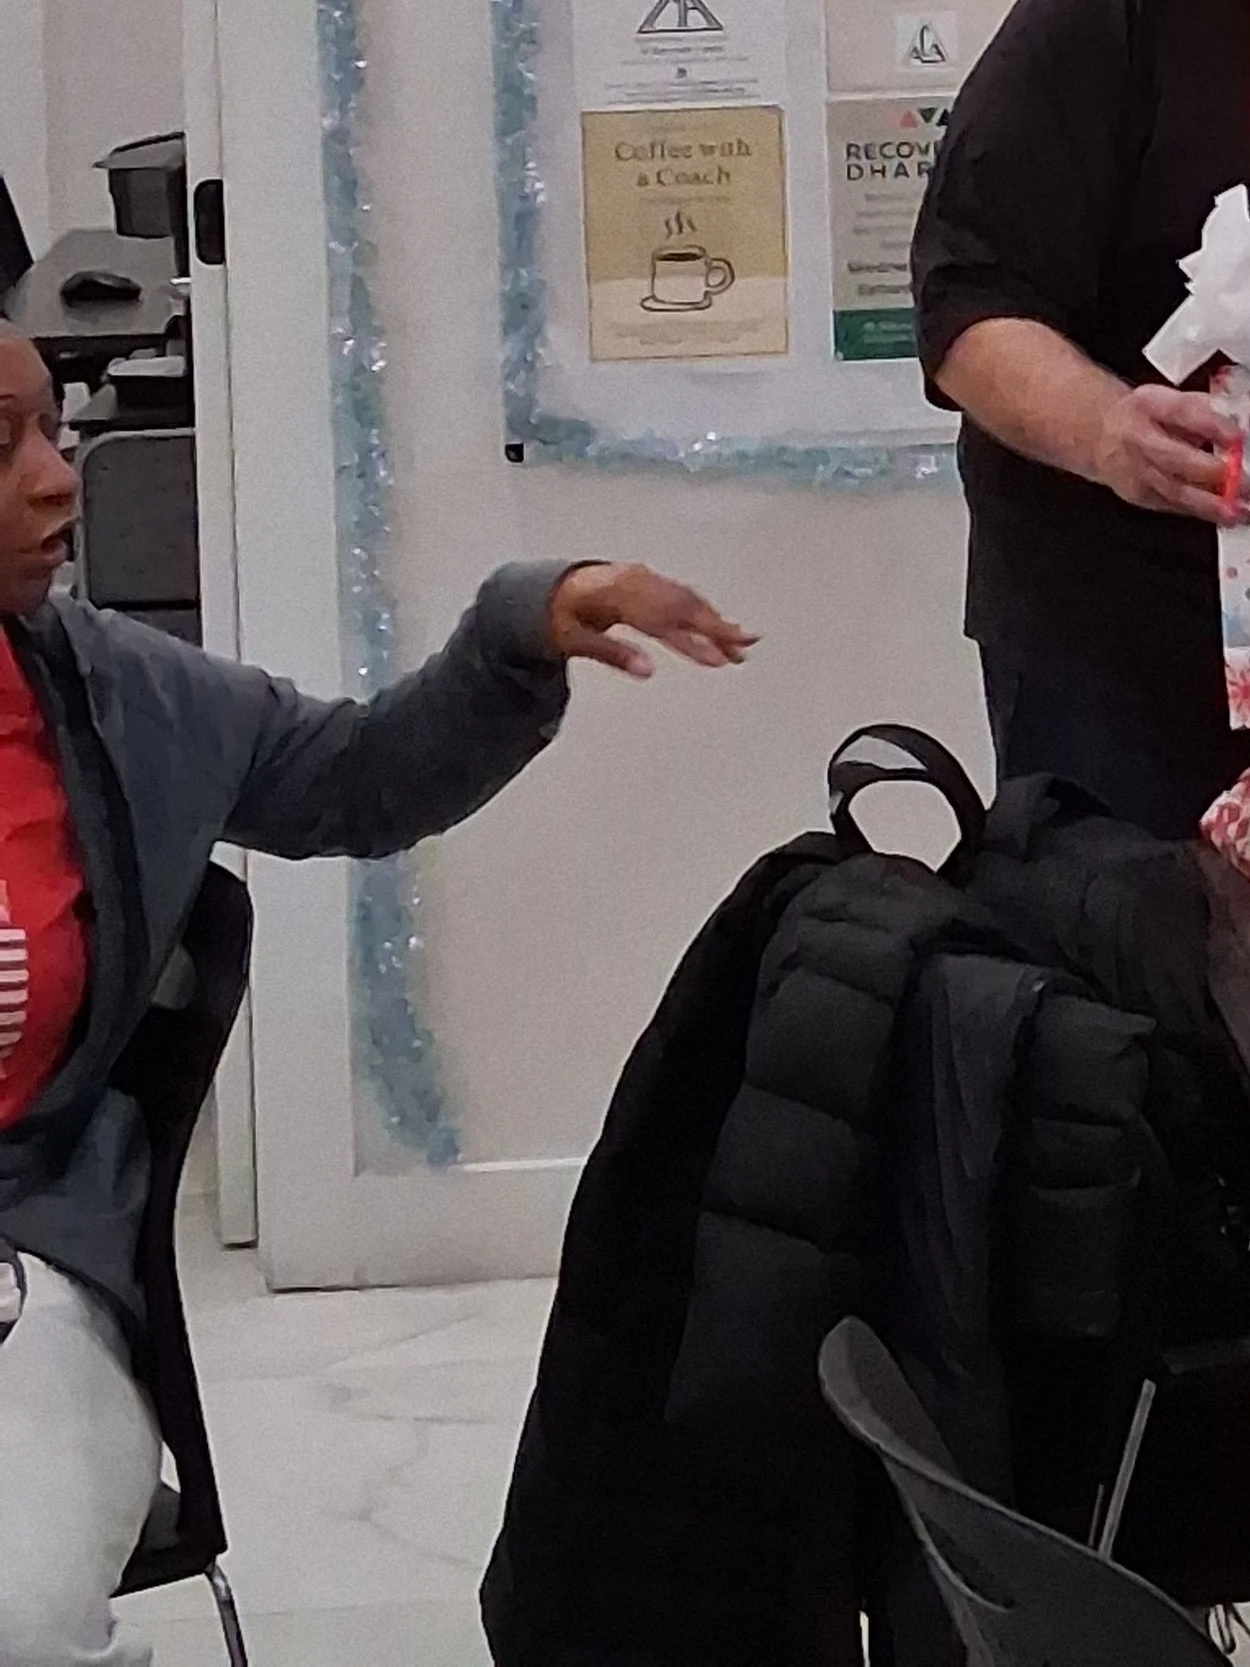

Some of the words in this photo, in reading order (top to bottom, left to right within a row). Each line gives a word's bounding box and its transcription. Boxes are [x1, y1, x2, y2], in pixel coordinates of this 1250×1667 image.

[615, 140, 692, 162] Coffee
[698, 137, 752, 159] with
[636, 172, 649, 187] a
[656, 166, 732, 187] Coach
